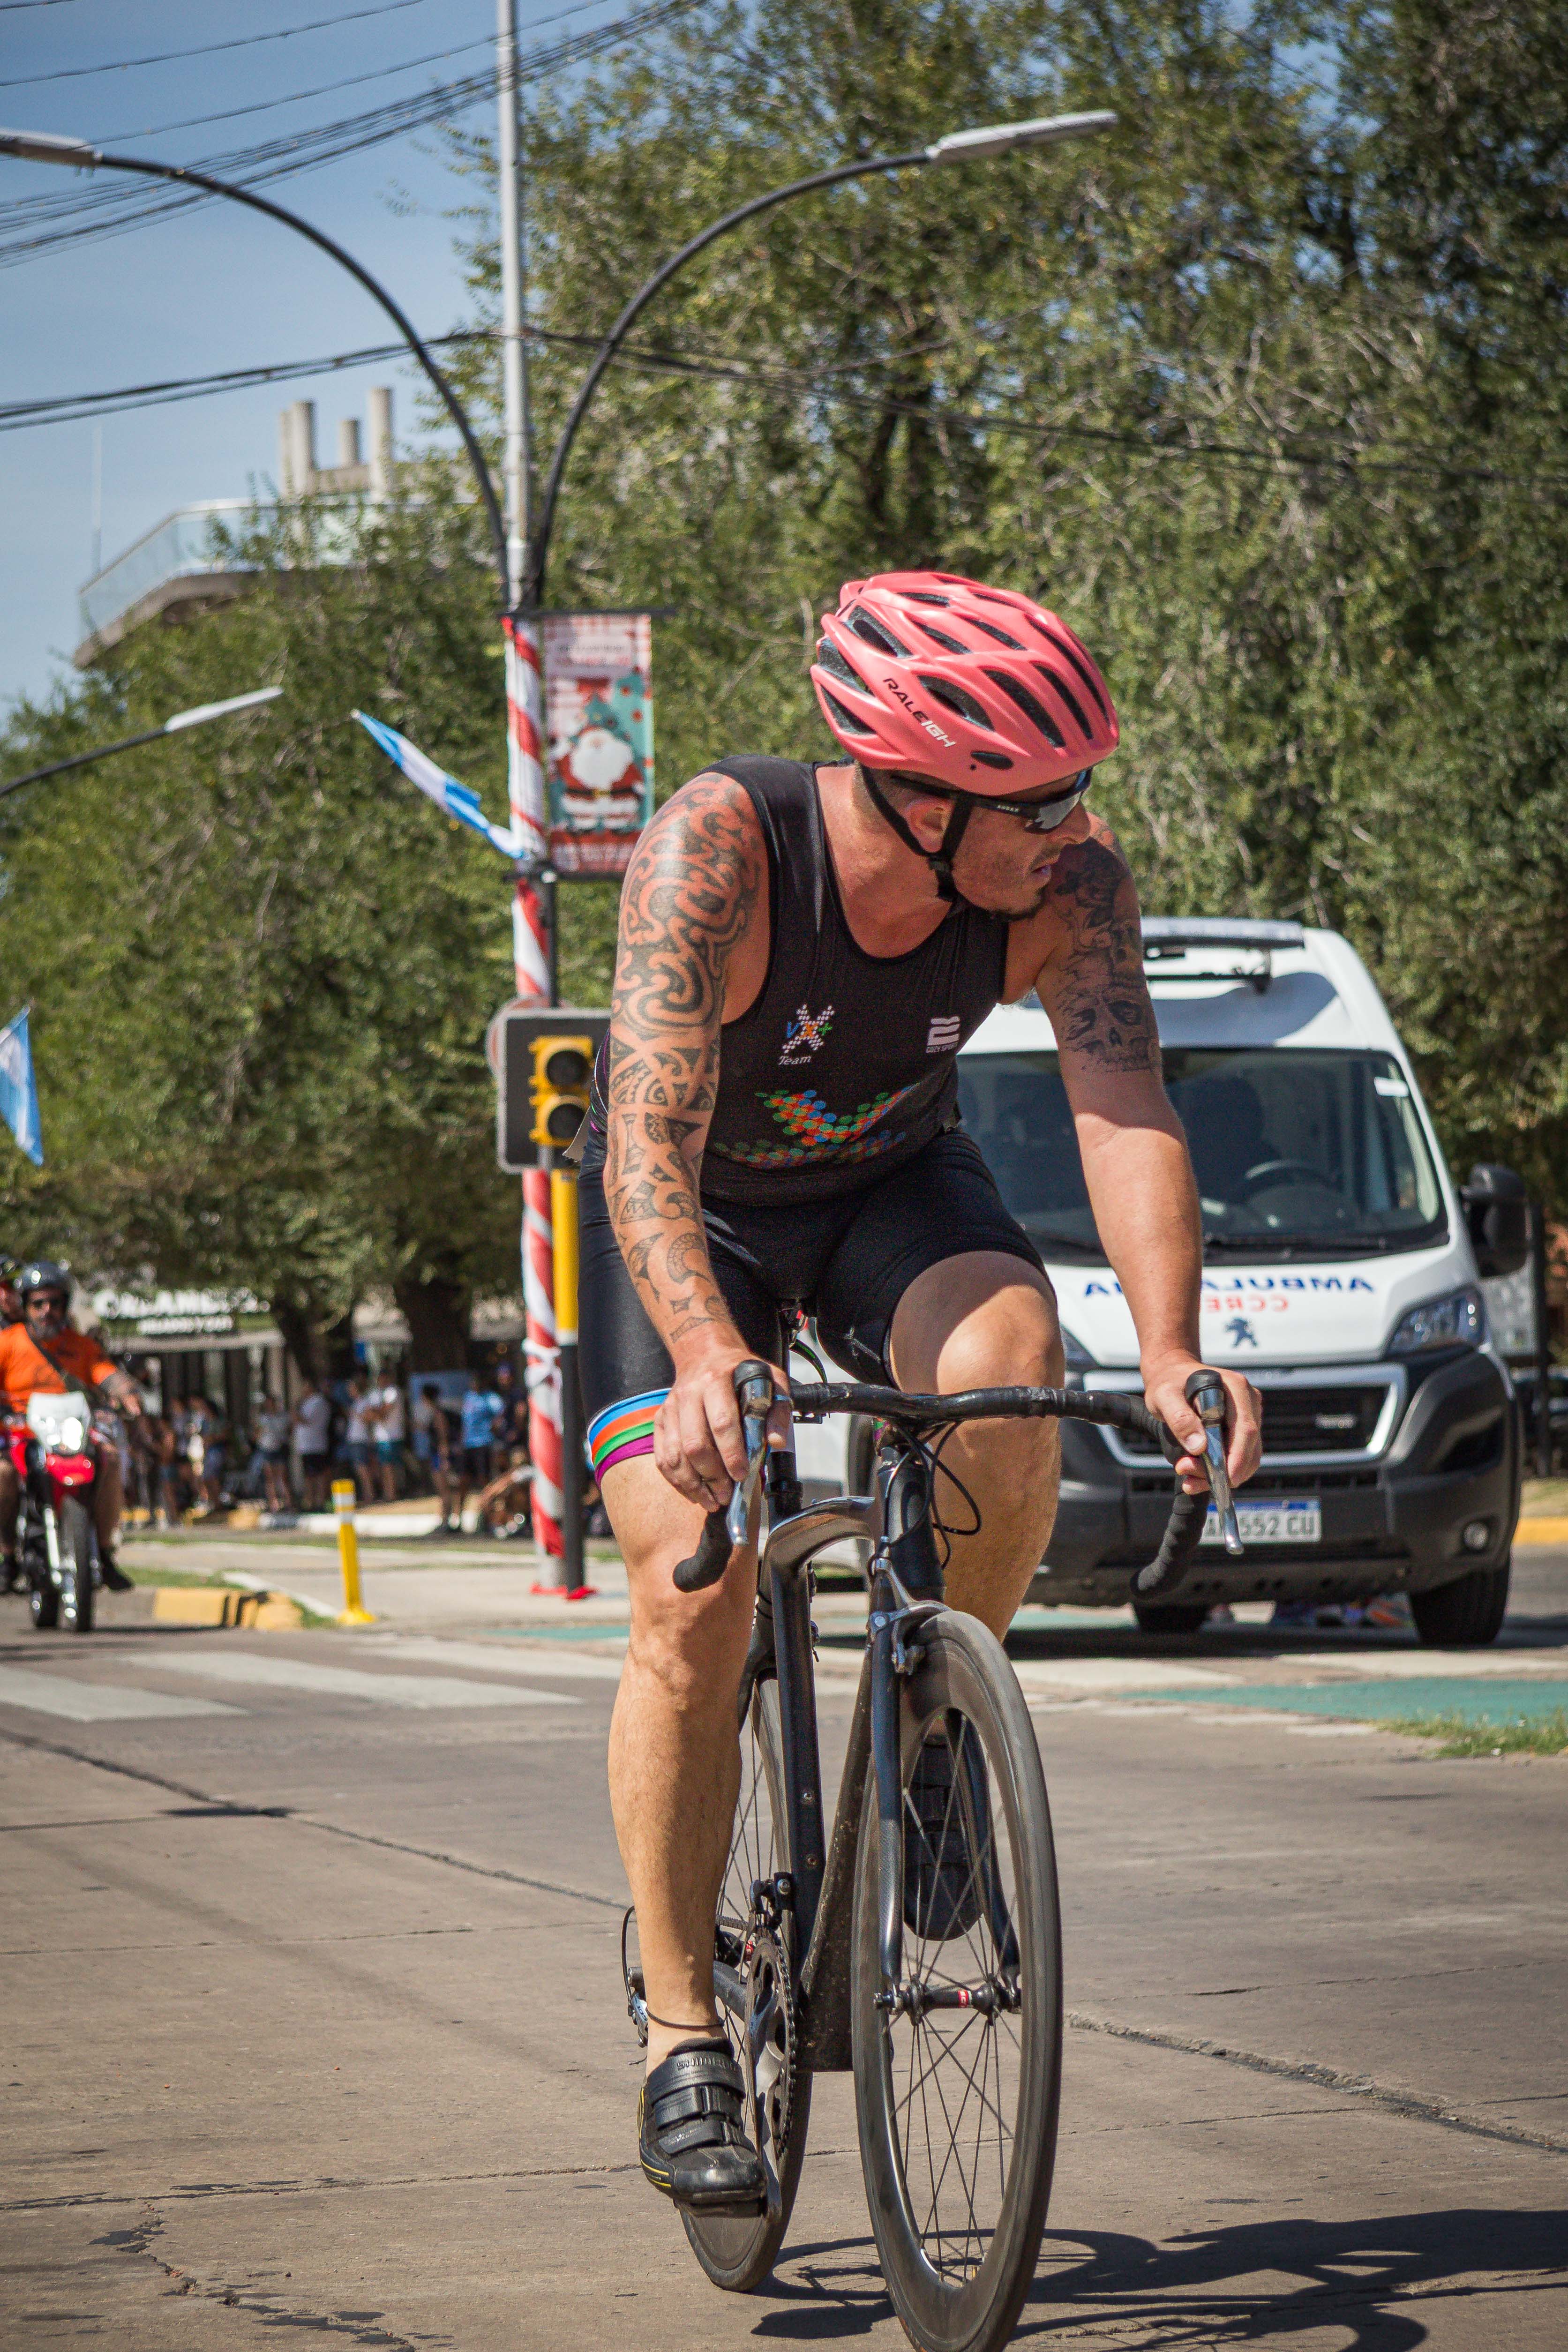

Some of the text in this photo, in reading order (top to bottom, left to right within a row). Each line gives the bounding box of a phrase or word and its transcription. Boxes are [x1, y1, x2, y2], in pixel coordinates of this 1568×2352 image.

[883, 678, 956, 748] RALEIGH
[778, 1056, 811, 1065] Team
[1238, 1515, 1279, 1536] 552
[1287, 1515, 1315, 1536] CU
